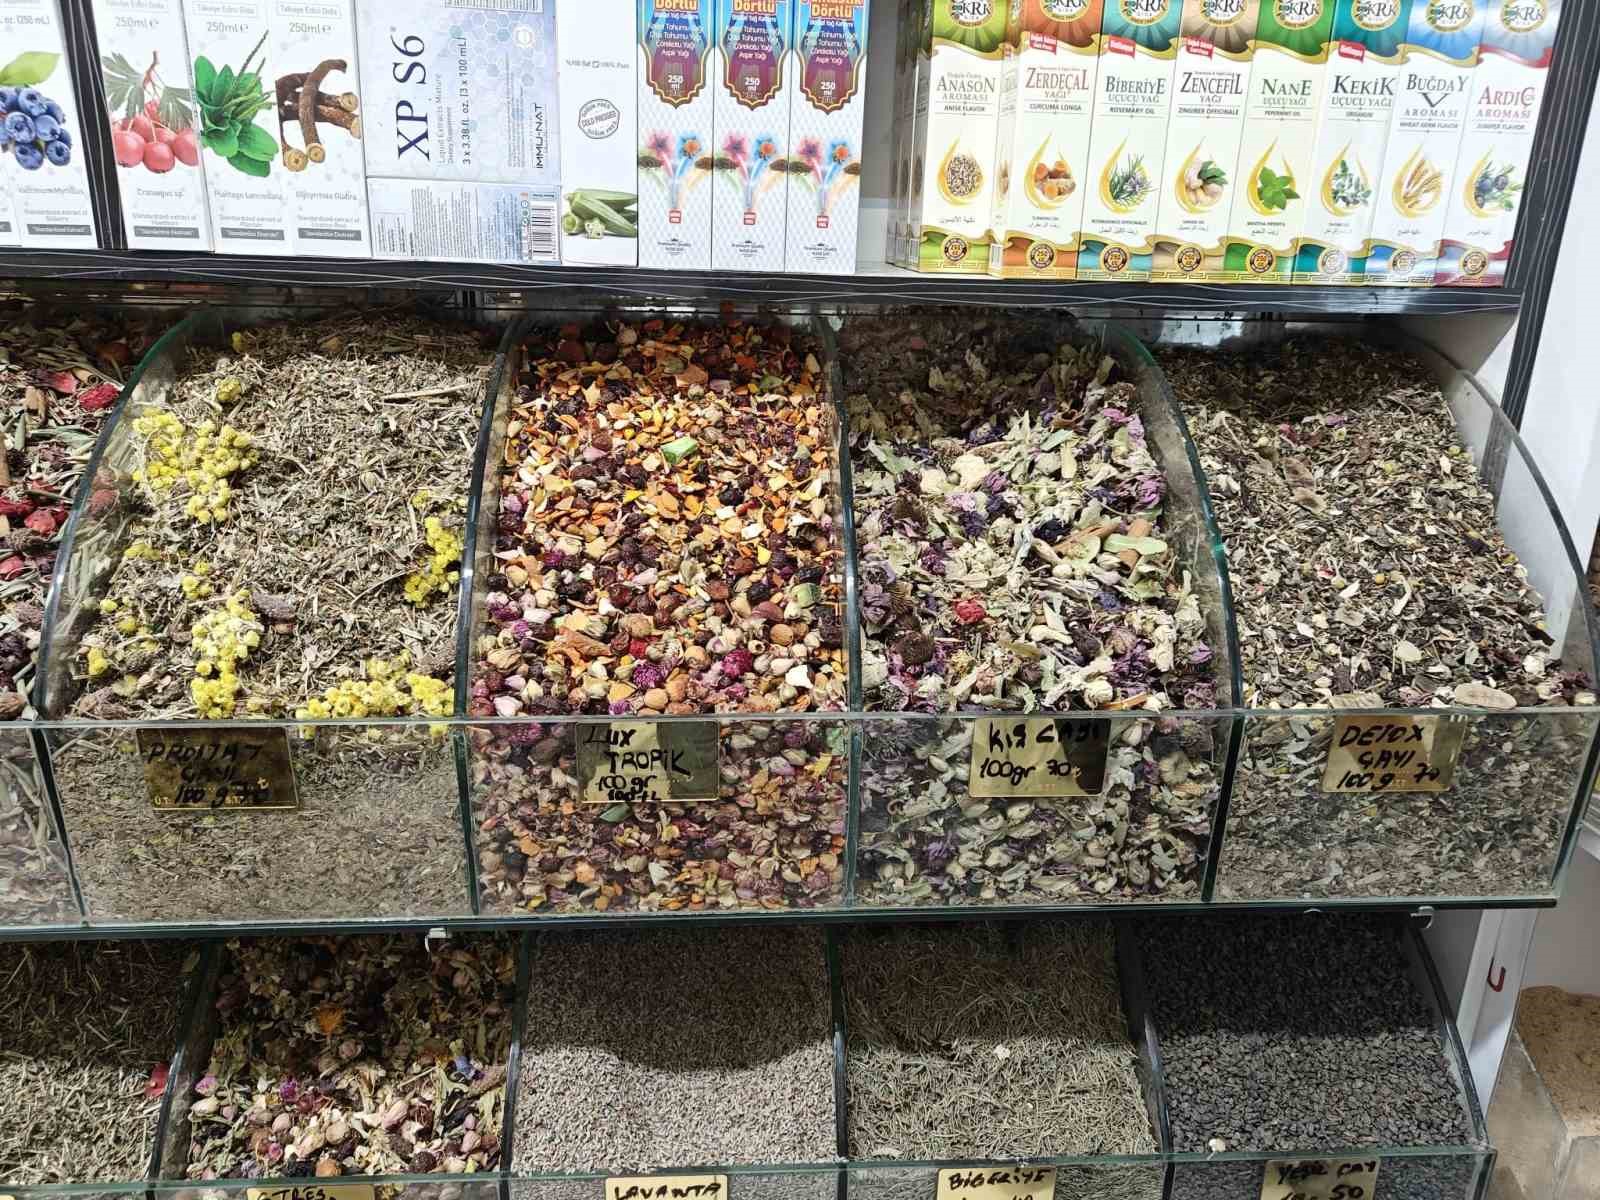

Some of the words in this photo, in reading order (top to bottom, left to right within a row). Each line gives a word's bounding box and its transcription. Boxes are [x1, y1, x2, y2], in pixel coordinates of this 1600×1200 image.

[811, 3, 853, 18] Dörtlü
[962, 2, 991, 16] KRK
[1289, 1, 1320, 13] KRK
[1367, 2, 1397, 16] KRK
[1439, 3, 1470, 18] KRK
[1514, 5, 1544, 20] KRK
[206, 21, 238, 33] 250ml
[289, 22, 320, 33] 250ml
[390, 34, 427, 85] S6
[458, 59, 467, 77] 100
[667, 75, 683, 83] 250
[744, 77, 760, 85] 250
[820, 81, 836, 89] 250
[936, 75, 997, 93] ANASON
[1105, 75, 1167, 95] BİBERİYE
[1180, 71, 1243, 95] ZENCEFİL
[1333, 74, 1396, 96] KEKİK
[1406, 73, 1469, 93] BUĞDAY
[1261, 78, 1313, 96] NANE
[942, 92, 988, 102] AROMASI
[1107, 93, 1139, 104] UÇUCU
[1331, 96, 1366, 107] UÇUCU
[1367, 97, 1392, 108] YAĞI
[1110, 106, 1144, 114] ROSEMARY
[1404, 108, 1459, 117] AROMASI
[1475, 109, 1532, 119] AROMASI
[395, 98, 431, 162] XP
[534, 102, 544, 169] IMMU-NAT
[1339, 724, 1424, 748] DETOX
[597, 775, 627, 791] 100
[1336, 770, 1374, 789] 100
